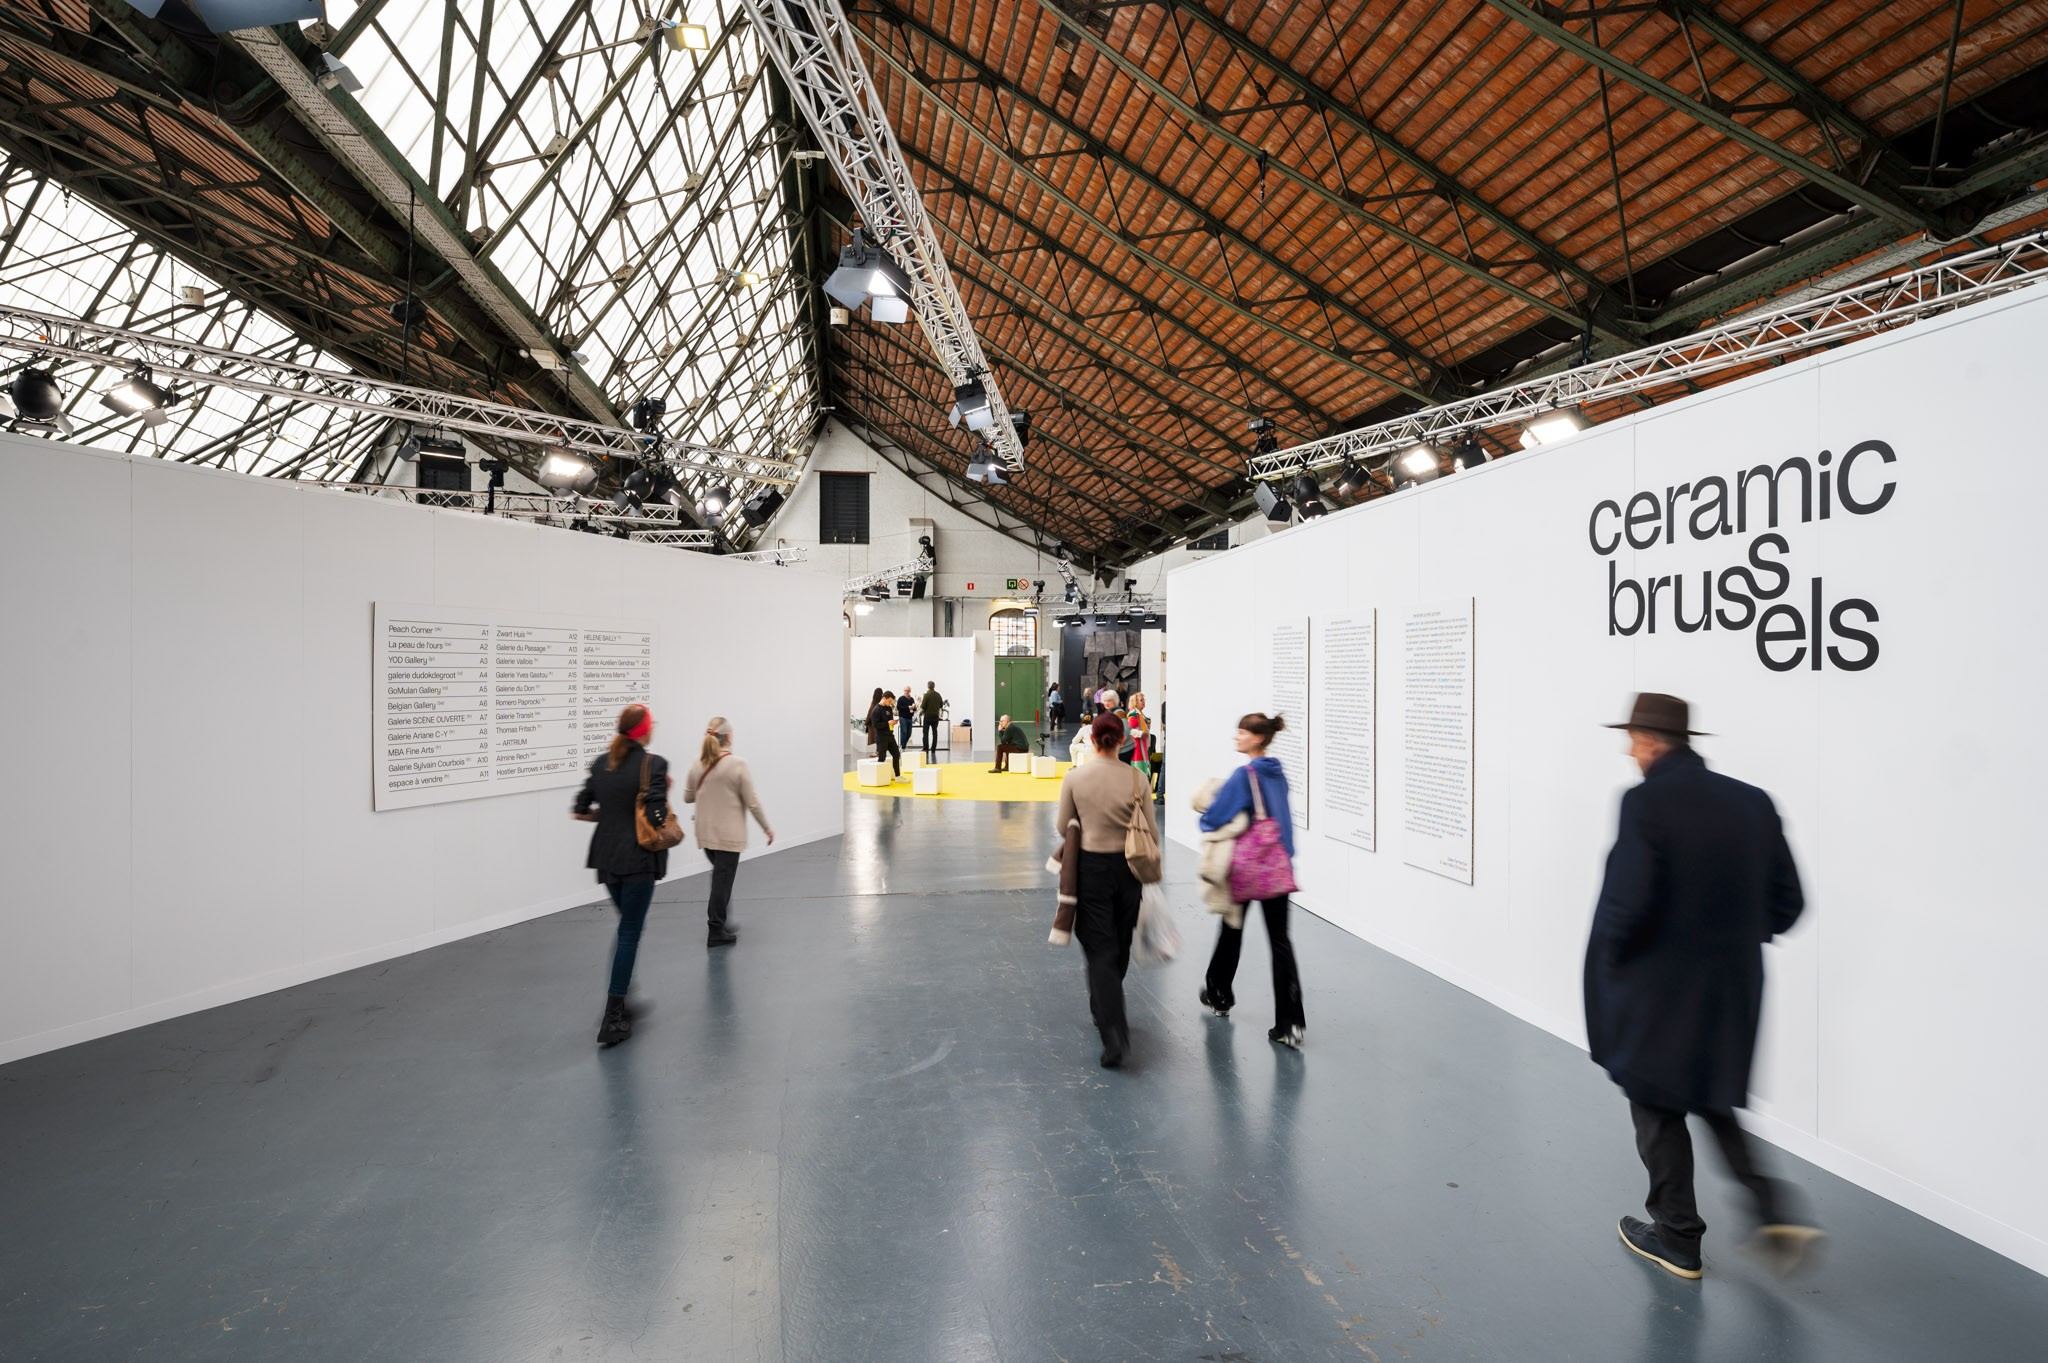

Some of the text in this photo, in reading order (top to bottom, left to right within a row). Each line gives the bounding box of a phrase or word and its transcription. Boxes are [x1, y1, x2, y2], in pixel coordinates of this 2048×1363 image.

[1589, 440, 1897, 555] ceramic
[1609, 533, 1880, 672] brussels
[388, 624, 409, 633] Peach
[411, 626, 433, 634] Corner
[398, 642, 415, 650] peau
[524, 644, 546, 653] Passage
[404, 656, 427, 665] Gallery
[388, 672, 410, 680] galerie
[412, 671, 456, 680] dudokdegroot
[419, 686, 441, 695] Gallery
[387, 702, 412, 711] Belgian
[413, 702, 436, 710] Gallery
[387, 718, 411, 726] Galerie
[436, 715, 465, 723] OUVERTE
[388, 764, 412, 772] Galerie
[413, 761, 436, 771] Sylvain
[437, 759, 465, 767] Courbois
[388, 779, 413, 788] espace
[421, 775, 443, 784] vendre
